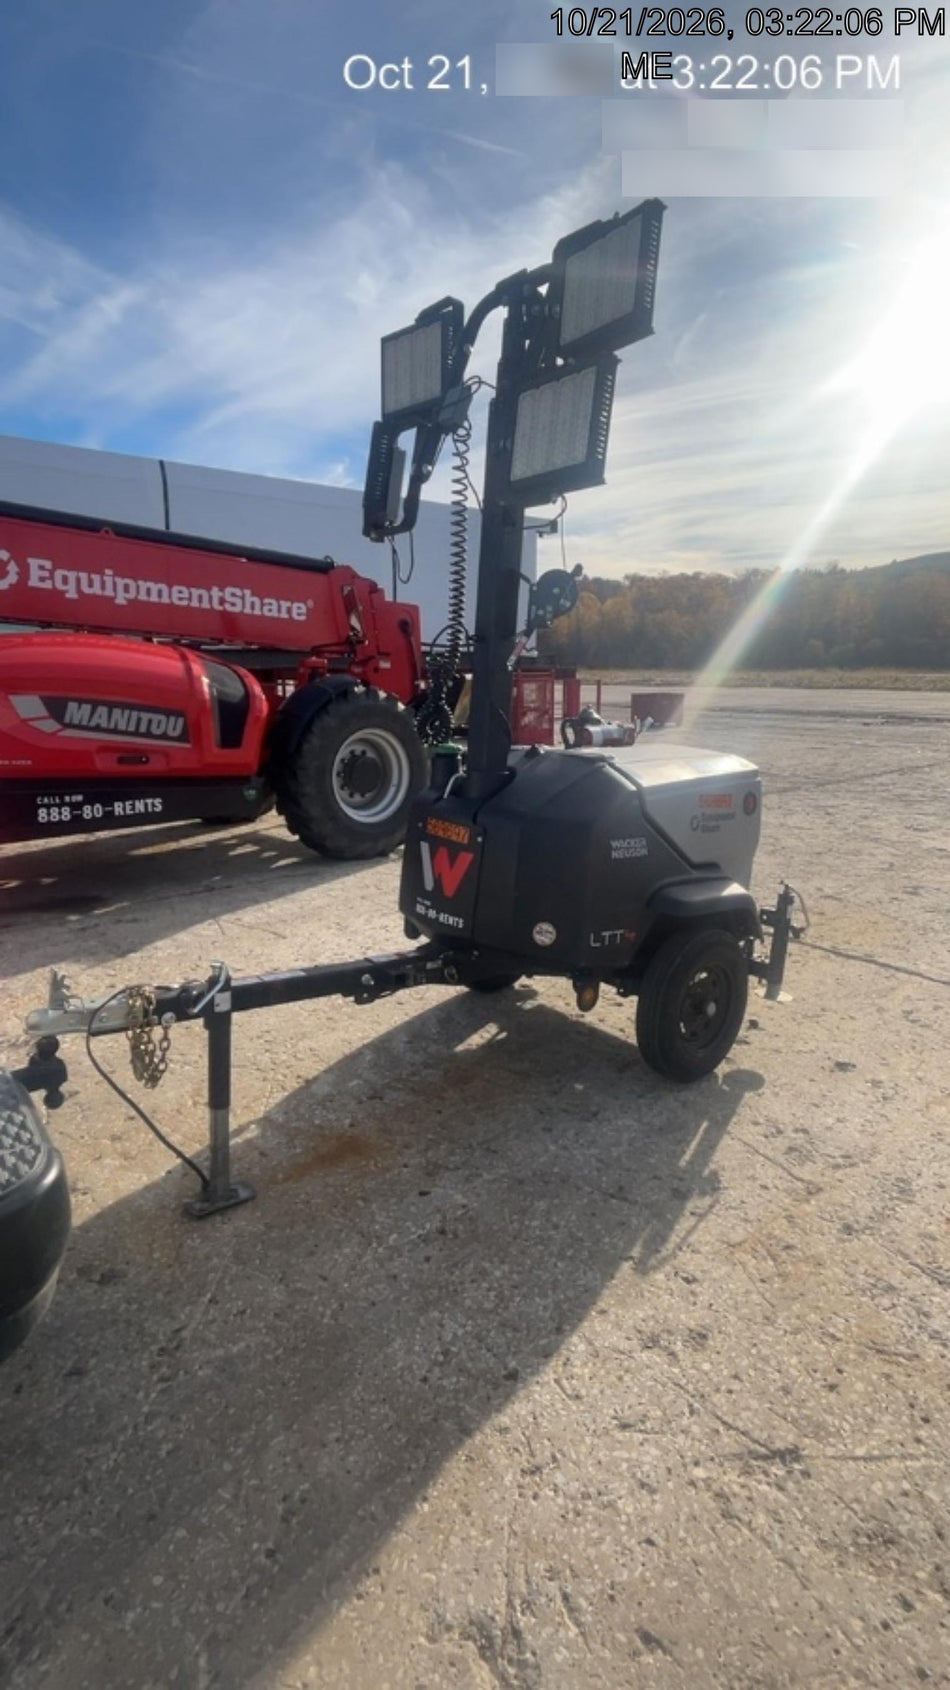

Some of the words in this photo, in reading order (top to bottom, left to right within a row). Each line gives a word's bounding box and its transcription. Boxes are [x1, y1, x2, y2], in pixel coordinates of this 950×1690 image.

[26, 556, 307, 621] EquipmentShare
[63, 701, 185, 737] MANITOU
[37, 795, 61, 804] CALL
[37, 797, 163, 823] 888-80-RENTS
